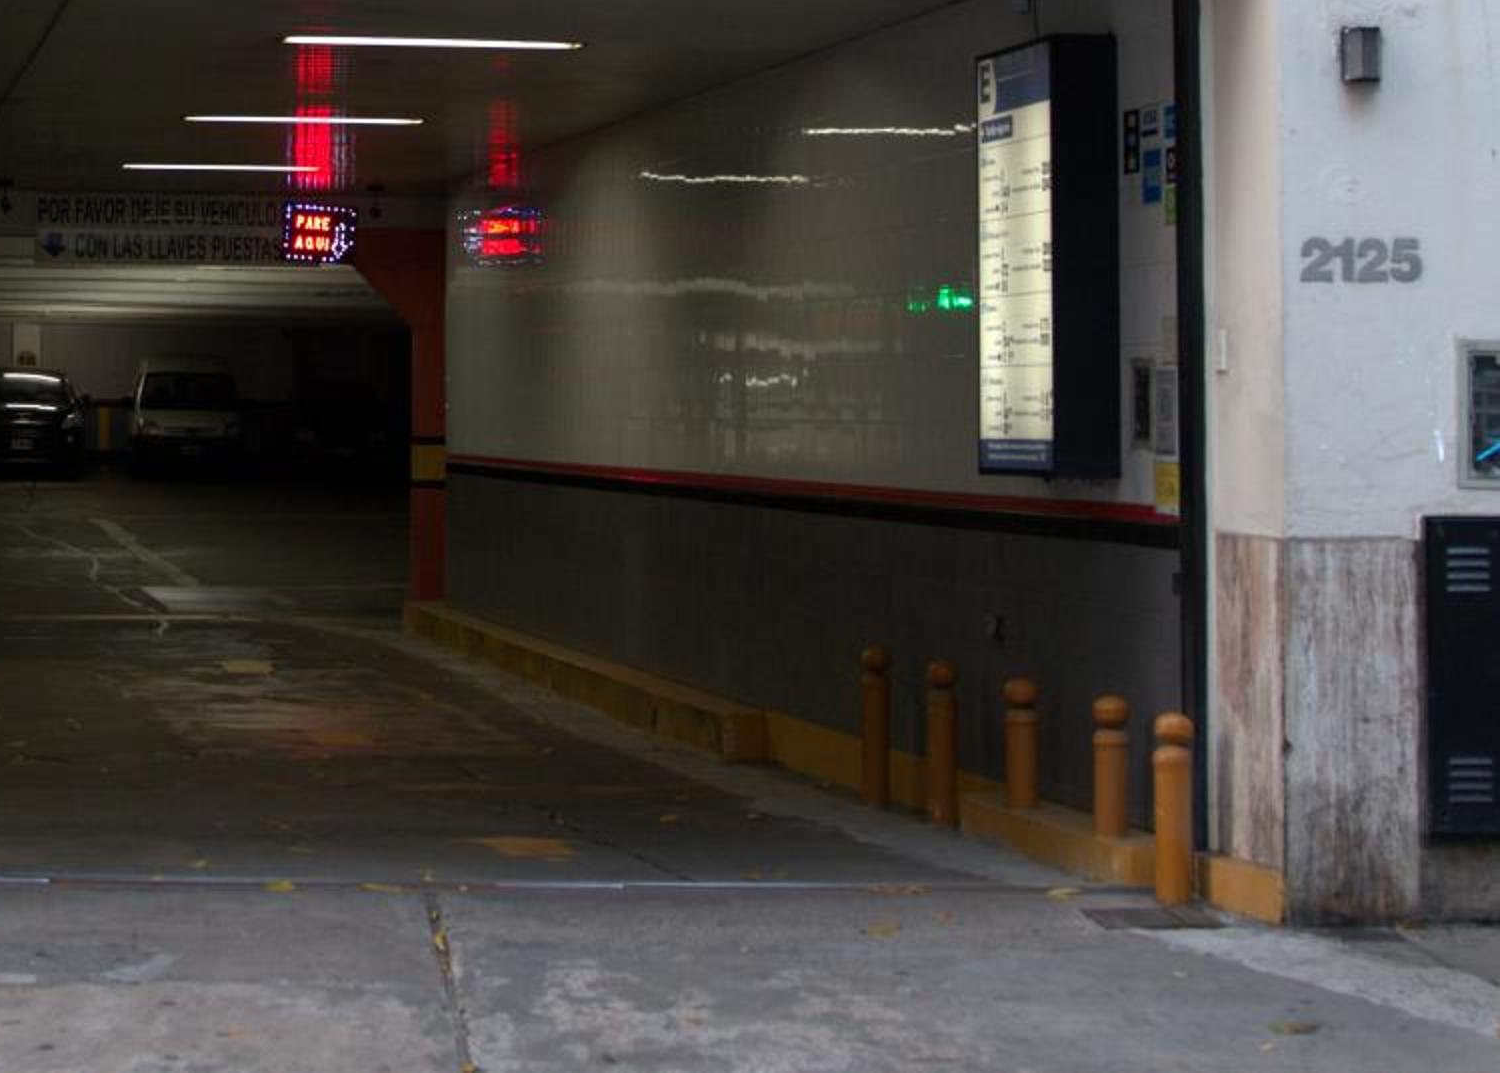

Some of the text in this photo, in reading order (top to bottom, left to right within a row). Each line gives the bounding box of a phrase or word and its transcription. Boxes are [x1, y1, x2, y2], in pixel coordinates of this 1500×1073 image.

[38, 198, 69, 224] POR
[75, 198, 126, 225] FAVOR
[174, 200, 196, 225] SU
[295, 213, 331, 232] PARE
[75, 232, 280, 261] CON LAS LLAVES PUESTAS
[294, 234, 330, 252] AQUI
[1299, 236, 1424, 285] 2125
